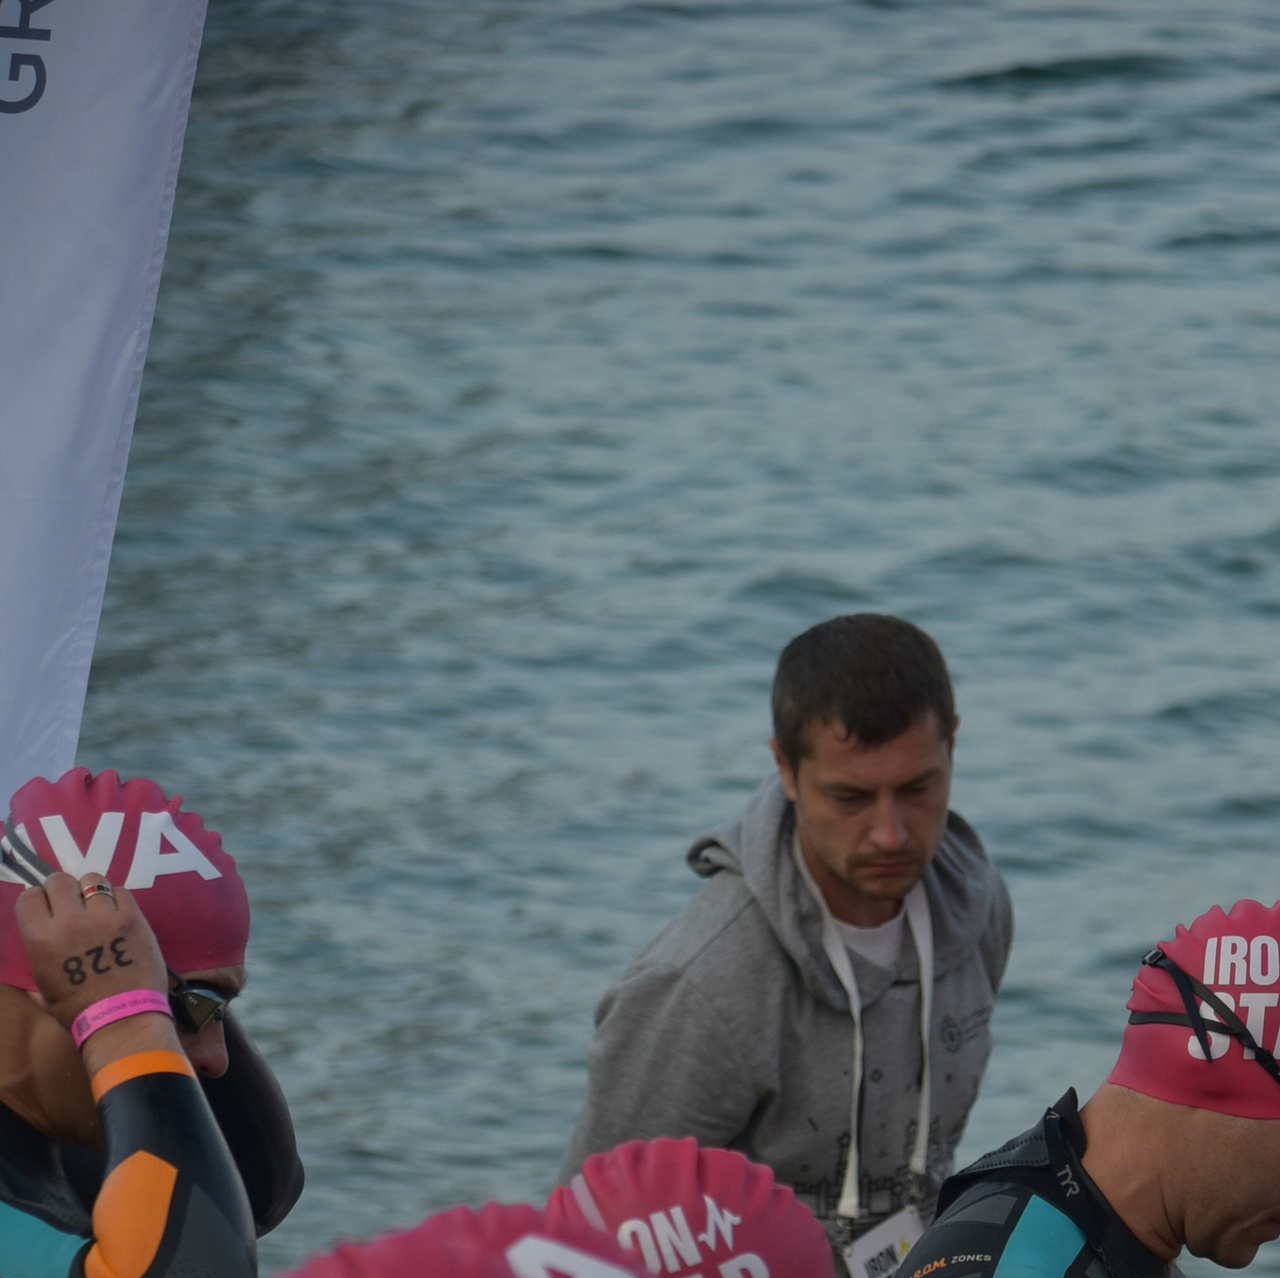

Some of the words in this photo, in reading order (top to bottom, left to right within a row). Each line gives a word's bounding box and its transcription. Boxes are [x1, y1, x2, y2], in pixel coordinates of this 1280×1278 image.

[62, 937, 134, 986] 328
[1056, 1164, 1080, 1198] TYR
[951, 1254, 991, 1264] ZONES
